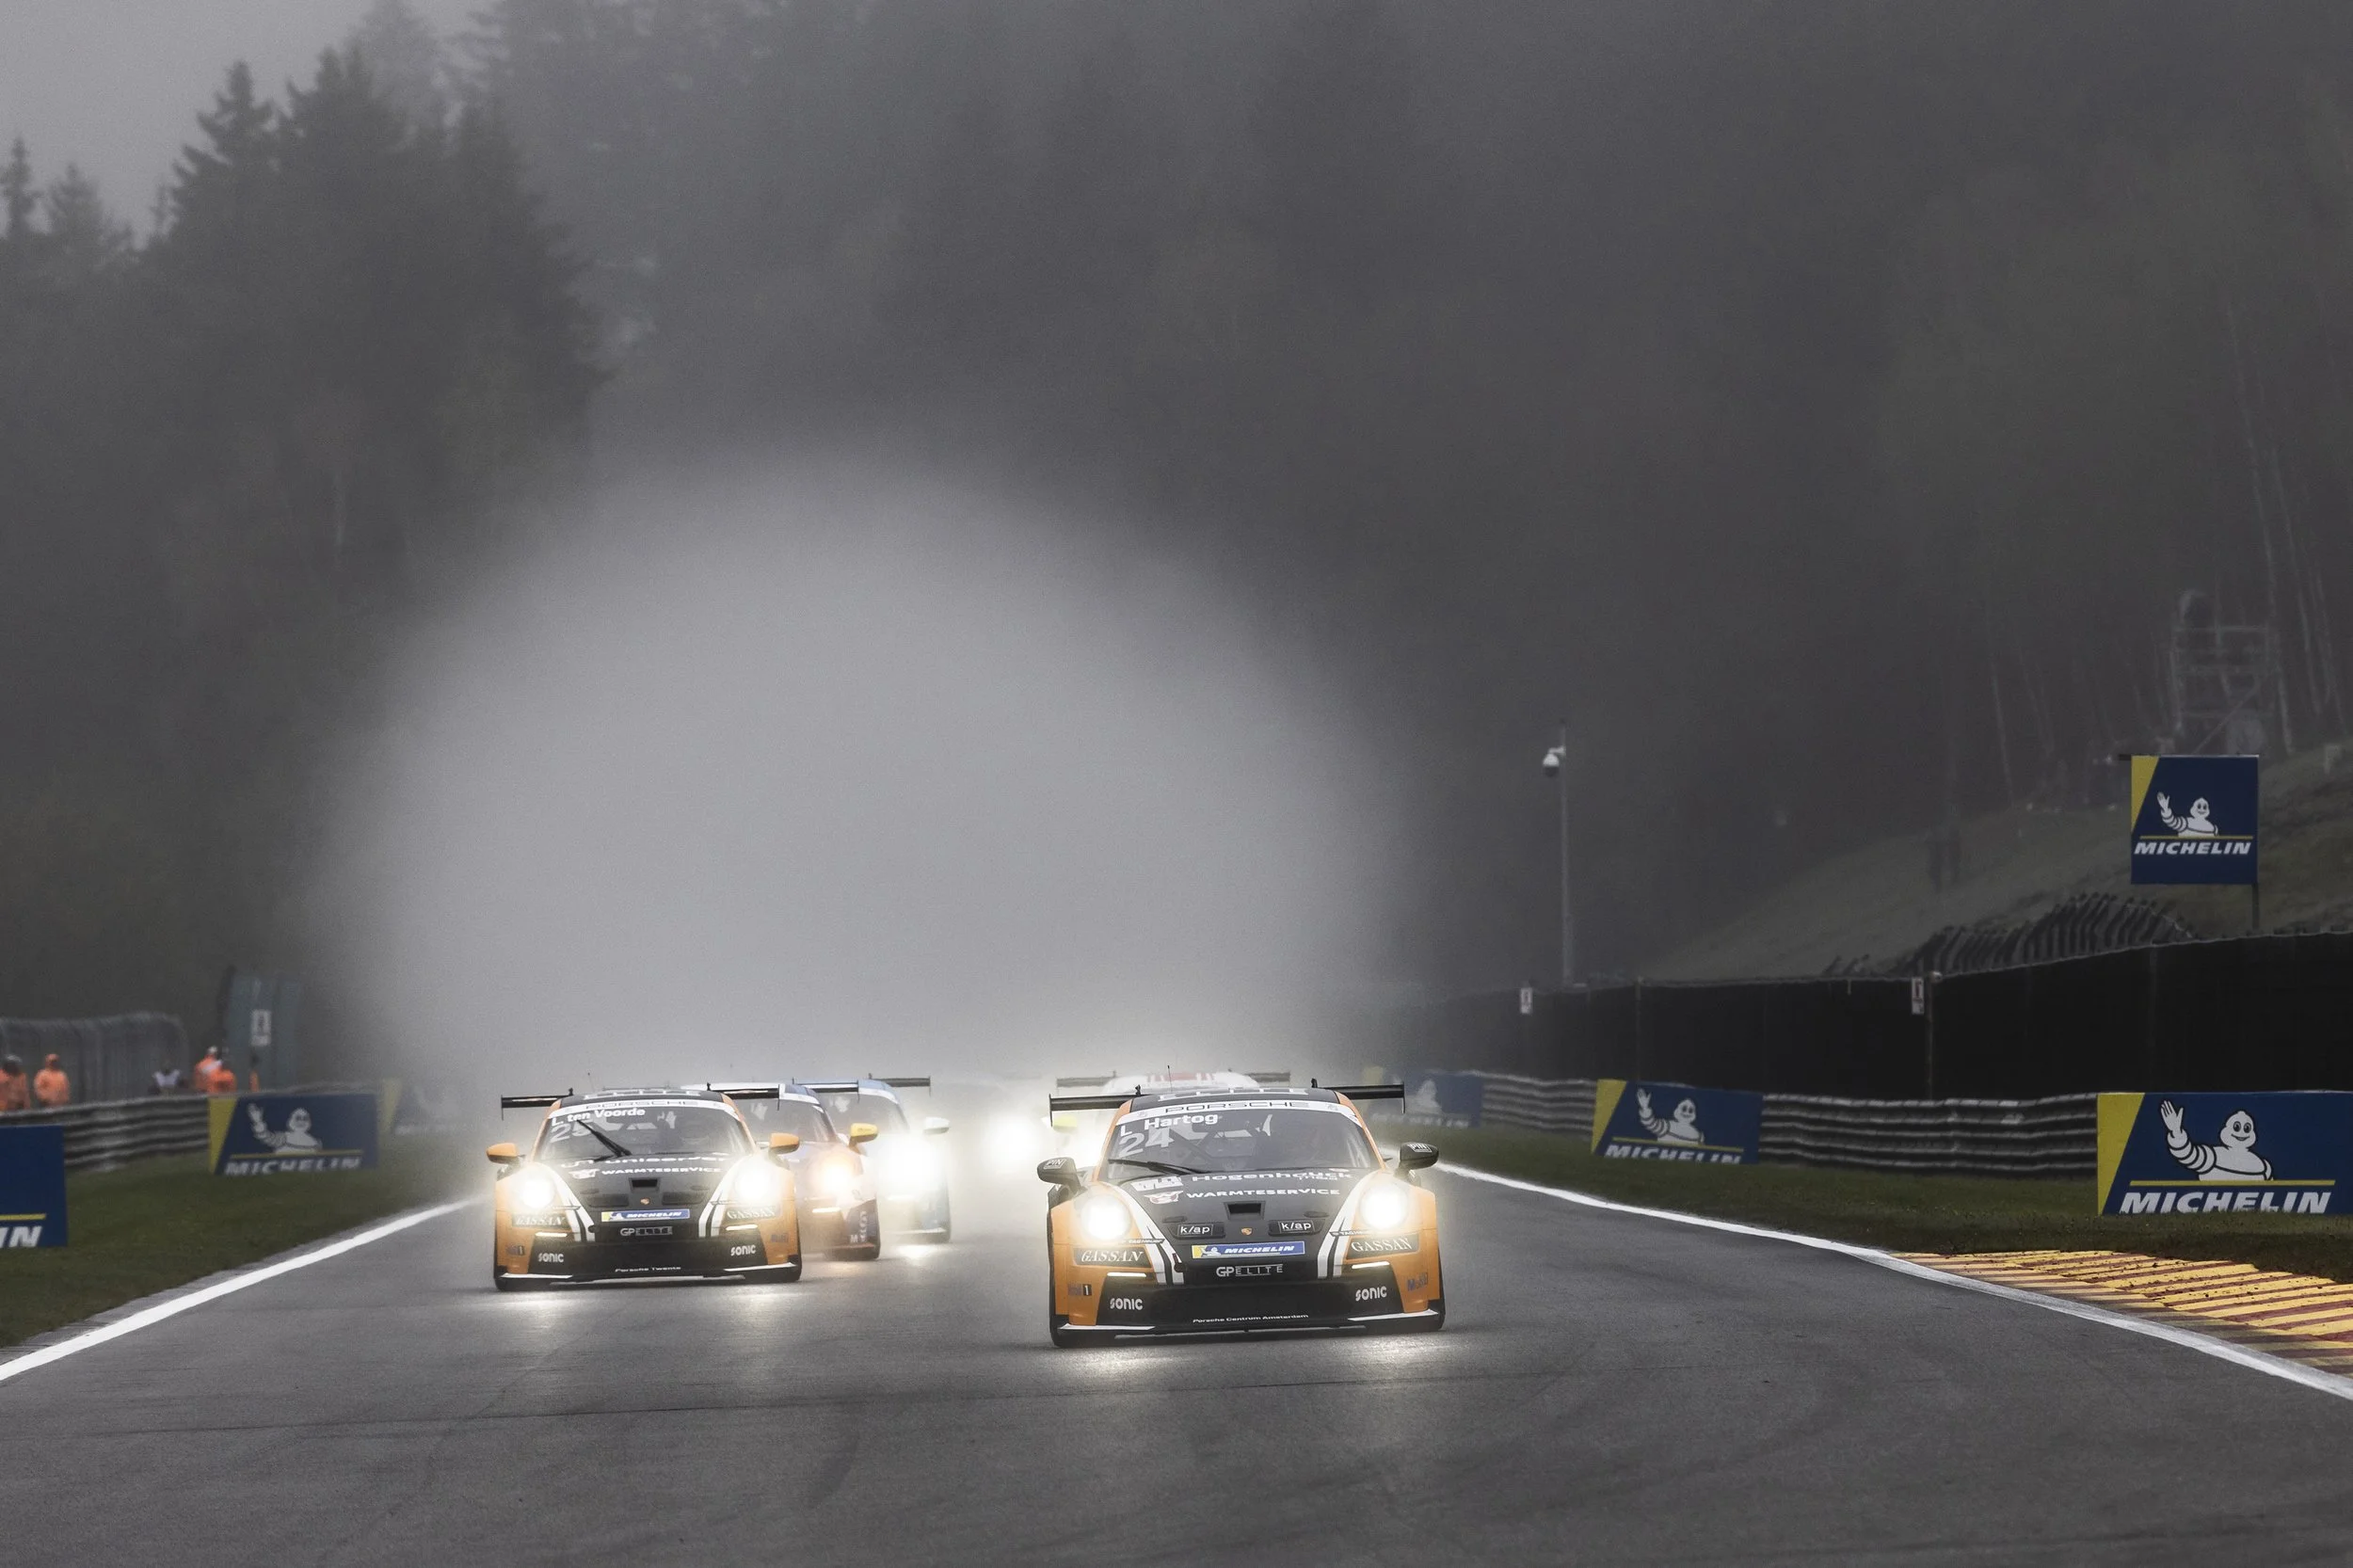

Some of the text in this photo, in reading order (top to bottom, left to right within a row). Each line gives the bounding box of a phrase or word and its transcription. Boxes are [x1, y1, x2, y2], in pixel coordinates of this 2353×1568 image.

[2134, 841, 2251, 855] MICHELIN
[1165, 1101, 1308, 1113] PORSCHE
[567, 1112, 591, 1123] ten
[594, 1108, 646, 1118] Voorde
[1144, 1113, 1219, 1131] Hartog
[1118, 1127, 1175, 1159] 24
[1604, 1144, 1741, 1163] MICHELIN
[225, 1157, 360, 1176] MICHELIN
[601, 1167, 722, 1176] WARMTESERVICE
[1187, 1188, 1340, 1199] WARMTESERVICE
[2119, 1192, 2331, 1214] MICHELIN
[1224, 1245, 1295, 1254] MICHELIN
[1351, 1237, 1414, 1253] GASSAN
[1080, 1250, 1144, 1262] GASSAN
